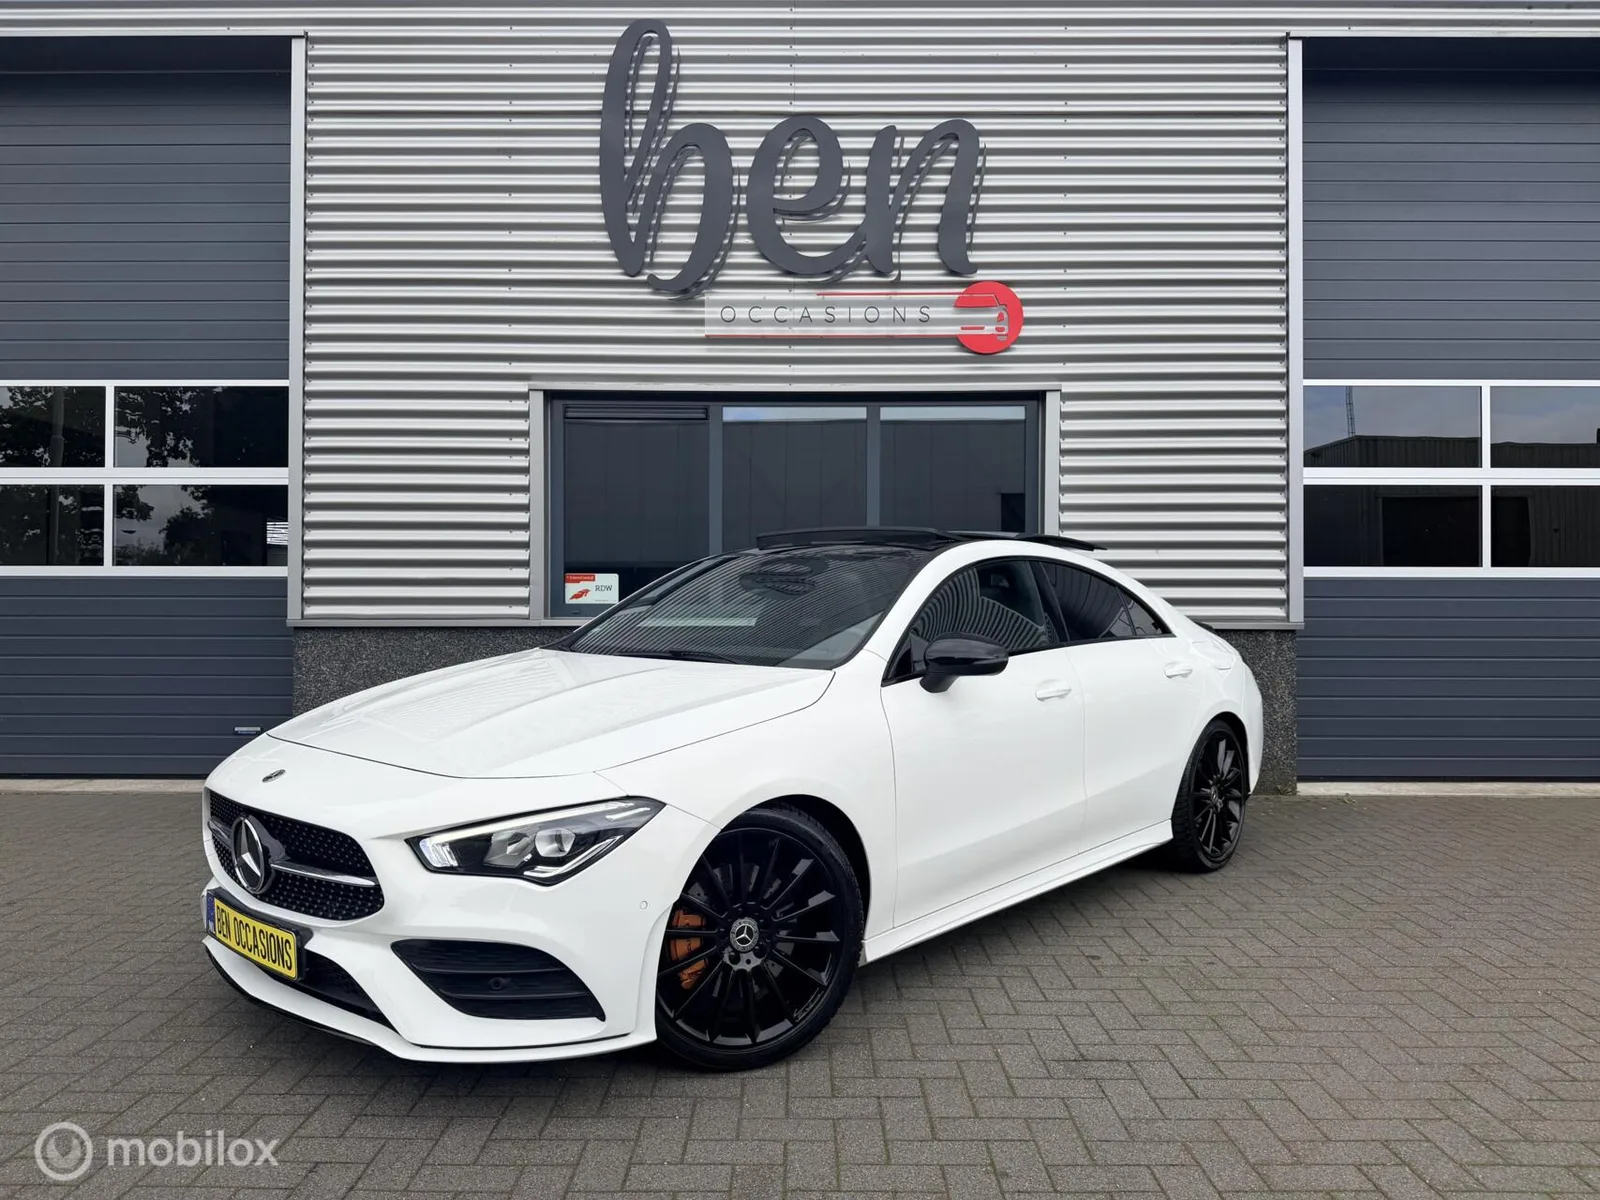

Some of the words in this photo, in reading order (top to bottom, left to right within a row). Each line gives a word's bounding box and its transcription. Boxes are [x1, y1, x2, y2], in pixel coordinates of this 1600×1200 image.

[600, 19, 981, 292] ben
[720, 305, 931, 324] OCCASIONS
[594, 584, 613, 592] RDW
[216, 904, 232, 942] BEN
[233, 916, 292, 971] OCCASIONS
